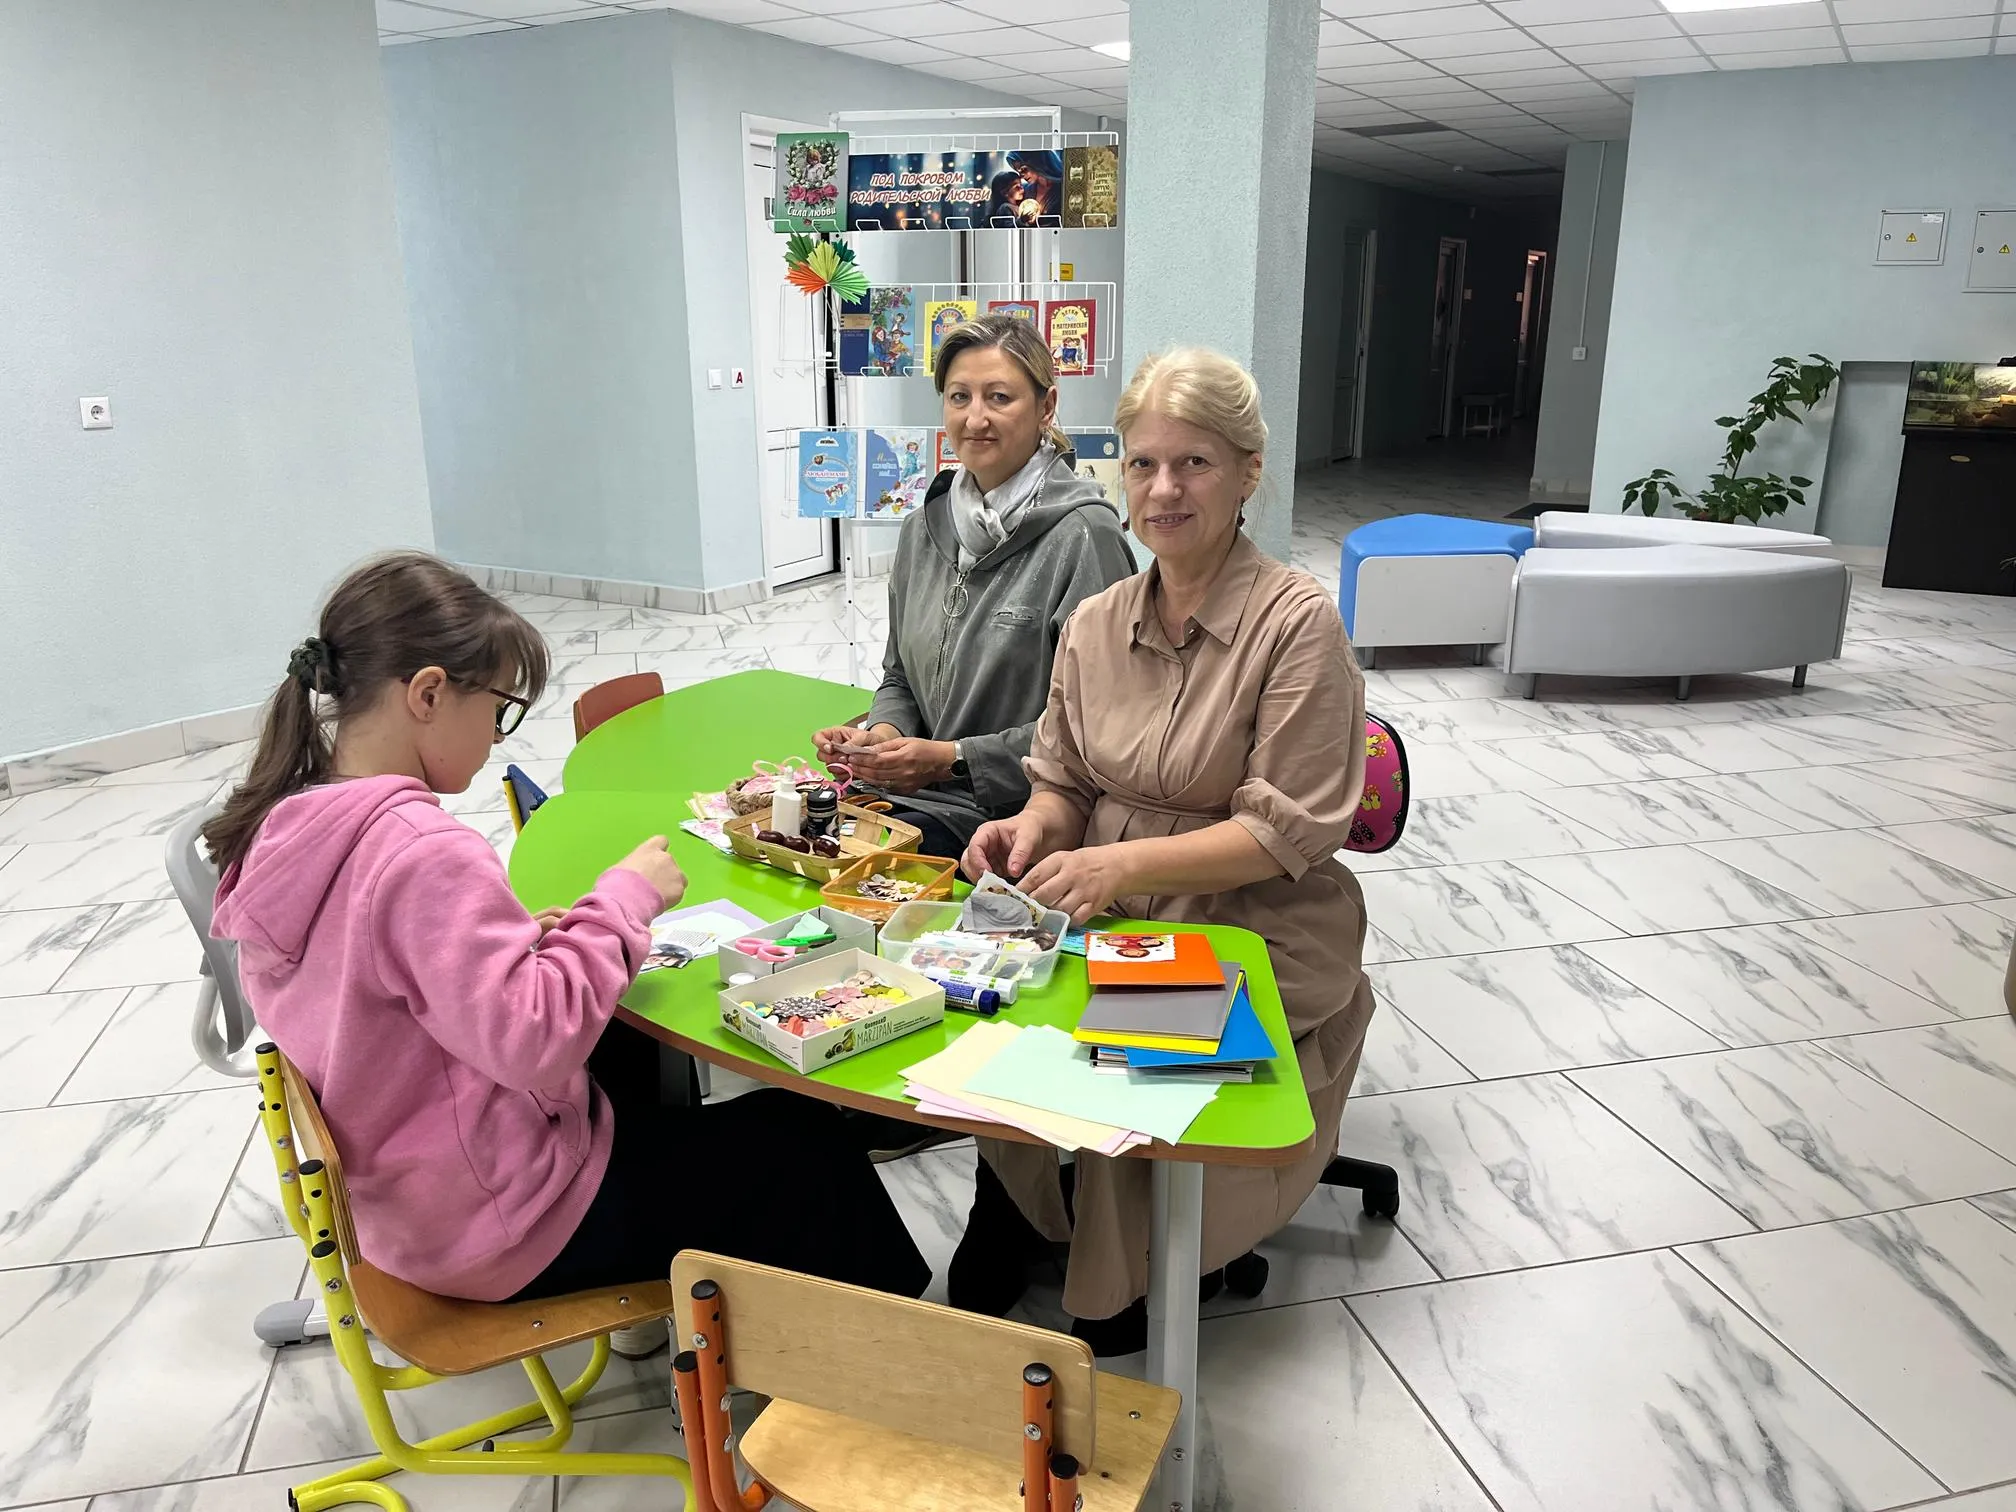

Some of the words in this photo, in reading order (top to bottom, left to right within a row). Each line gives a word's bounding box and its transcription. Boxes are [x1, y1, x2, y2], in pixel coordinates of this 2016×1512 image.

[870, 174, 895, 187] ПОД
[899, 172, 965, 186] ПОКРОВОМ
[850, 189, 942, 204] РОДИТЕЛЬСКОЙ
[945, 188, 992, 202] ЛЮБВИ
[787, 206, 807, 217] Сила
[808, 206, 836, 217] любви
[856, 1021, 893, 1048] MARZIPAN
